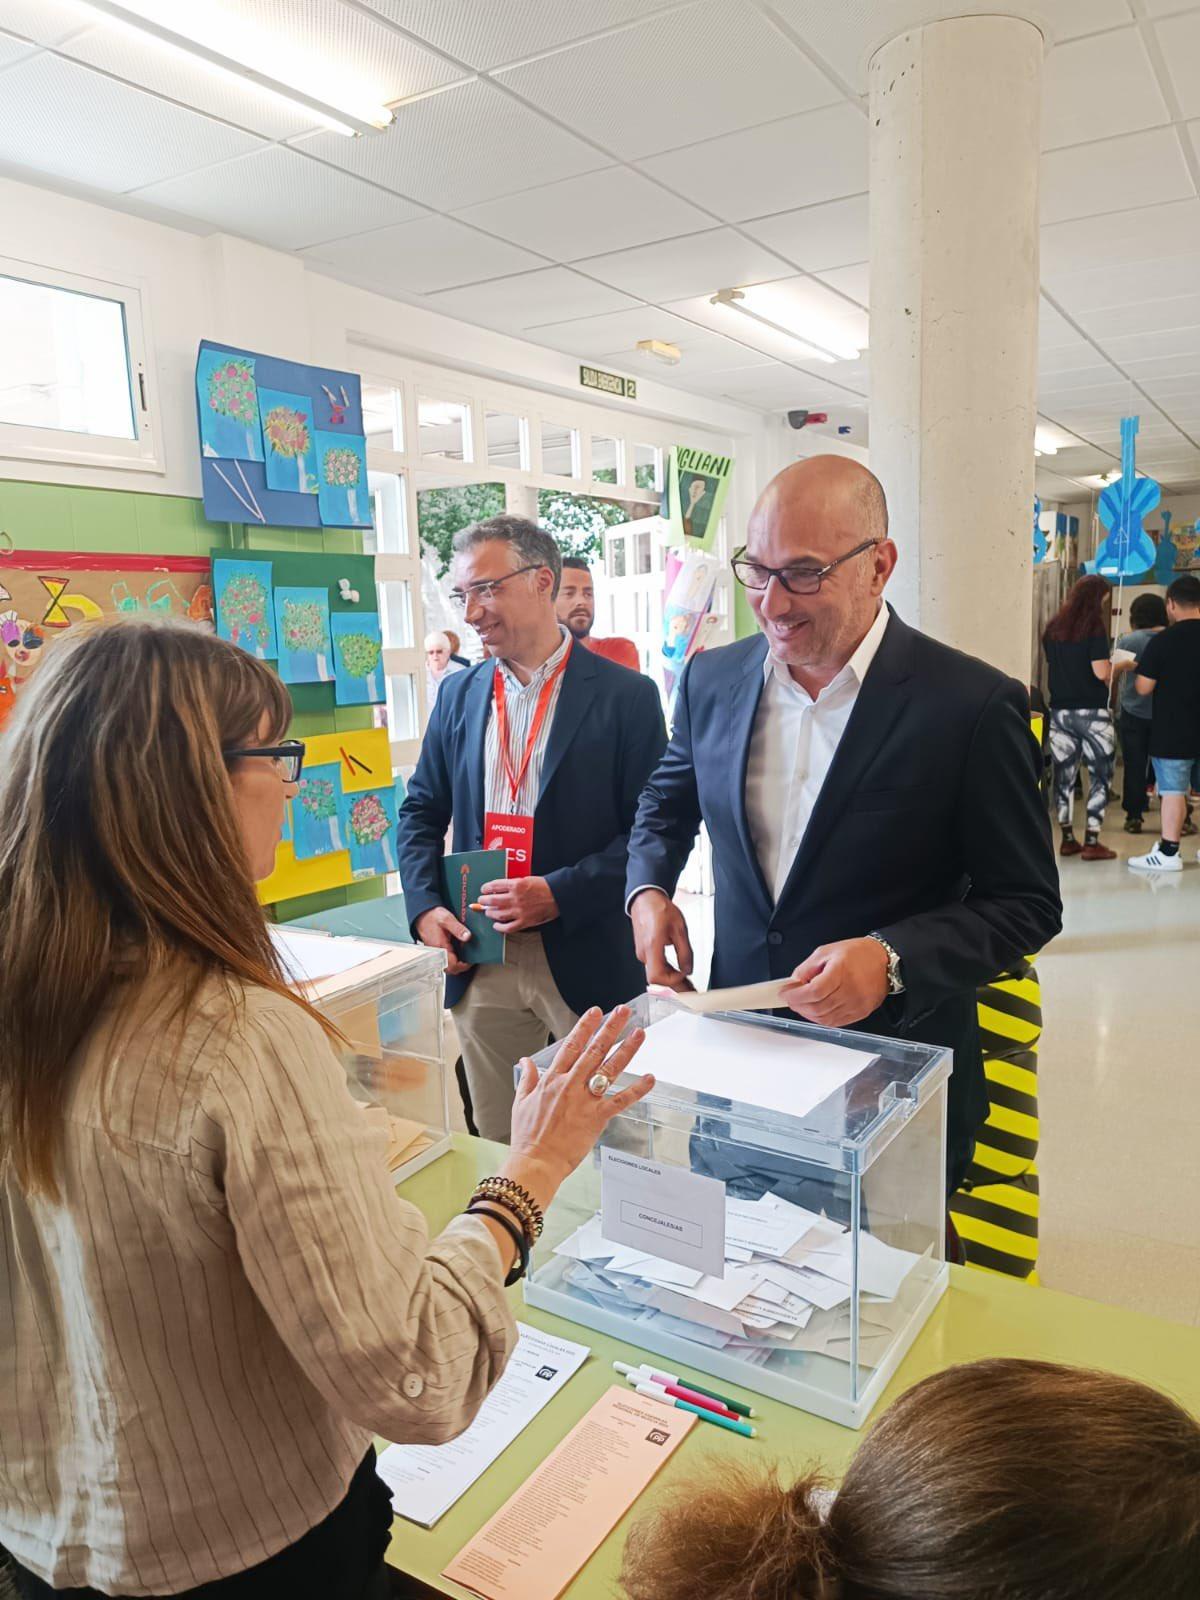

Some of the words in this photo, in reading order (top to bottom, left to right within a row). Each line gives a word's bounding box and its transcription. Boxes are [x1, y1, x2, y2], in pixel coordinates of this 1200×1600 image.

[628, 382, 635, 396] 2
[677, 446, 731, 477] IGLIANI
[491, 824, 526, 834] APODERADO
[608, 1155, 638, 1169] ELECCIONES
[638, 1164, 661, 1175] LOCALES
